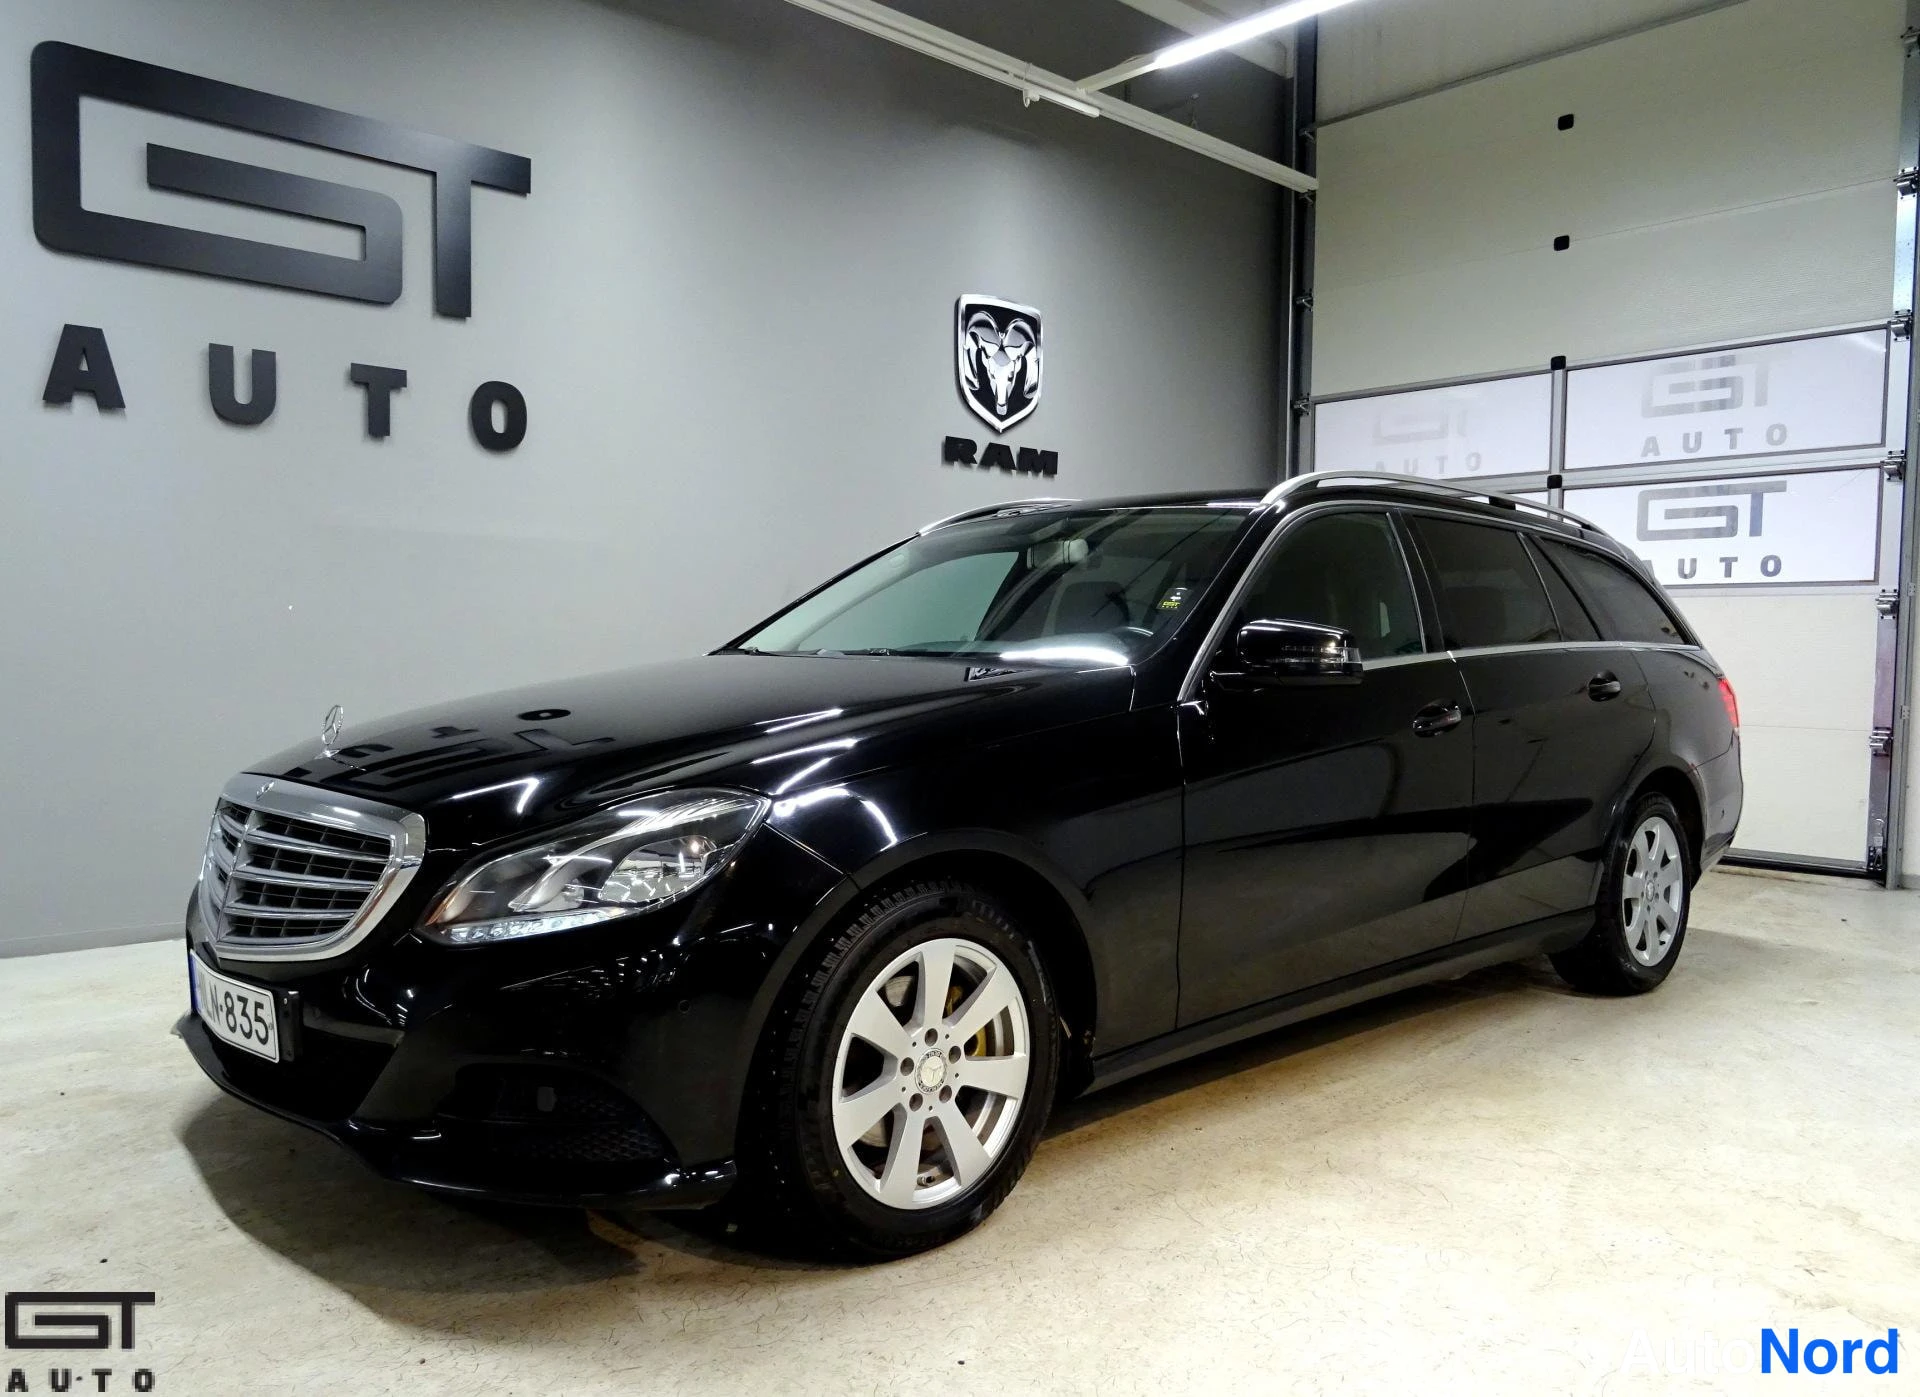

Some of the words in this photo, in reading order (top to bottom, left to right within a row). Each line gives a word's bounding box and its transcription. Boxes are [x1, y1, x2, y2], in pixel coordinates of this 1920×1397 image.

[42, 323, 528, 453] AUTO
[943, 436, 1058, 477] RAM
[1641, 423, 1788, 457] AUTO
